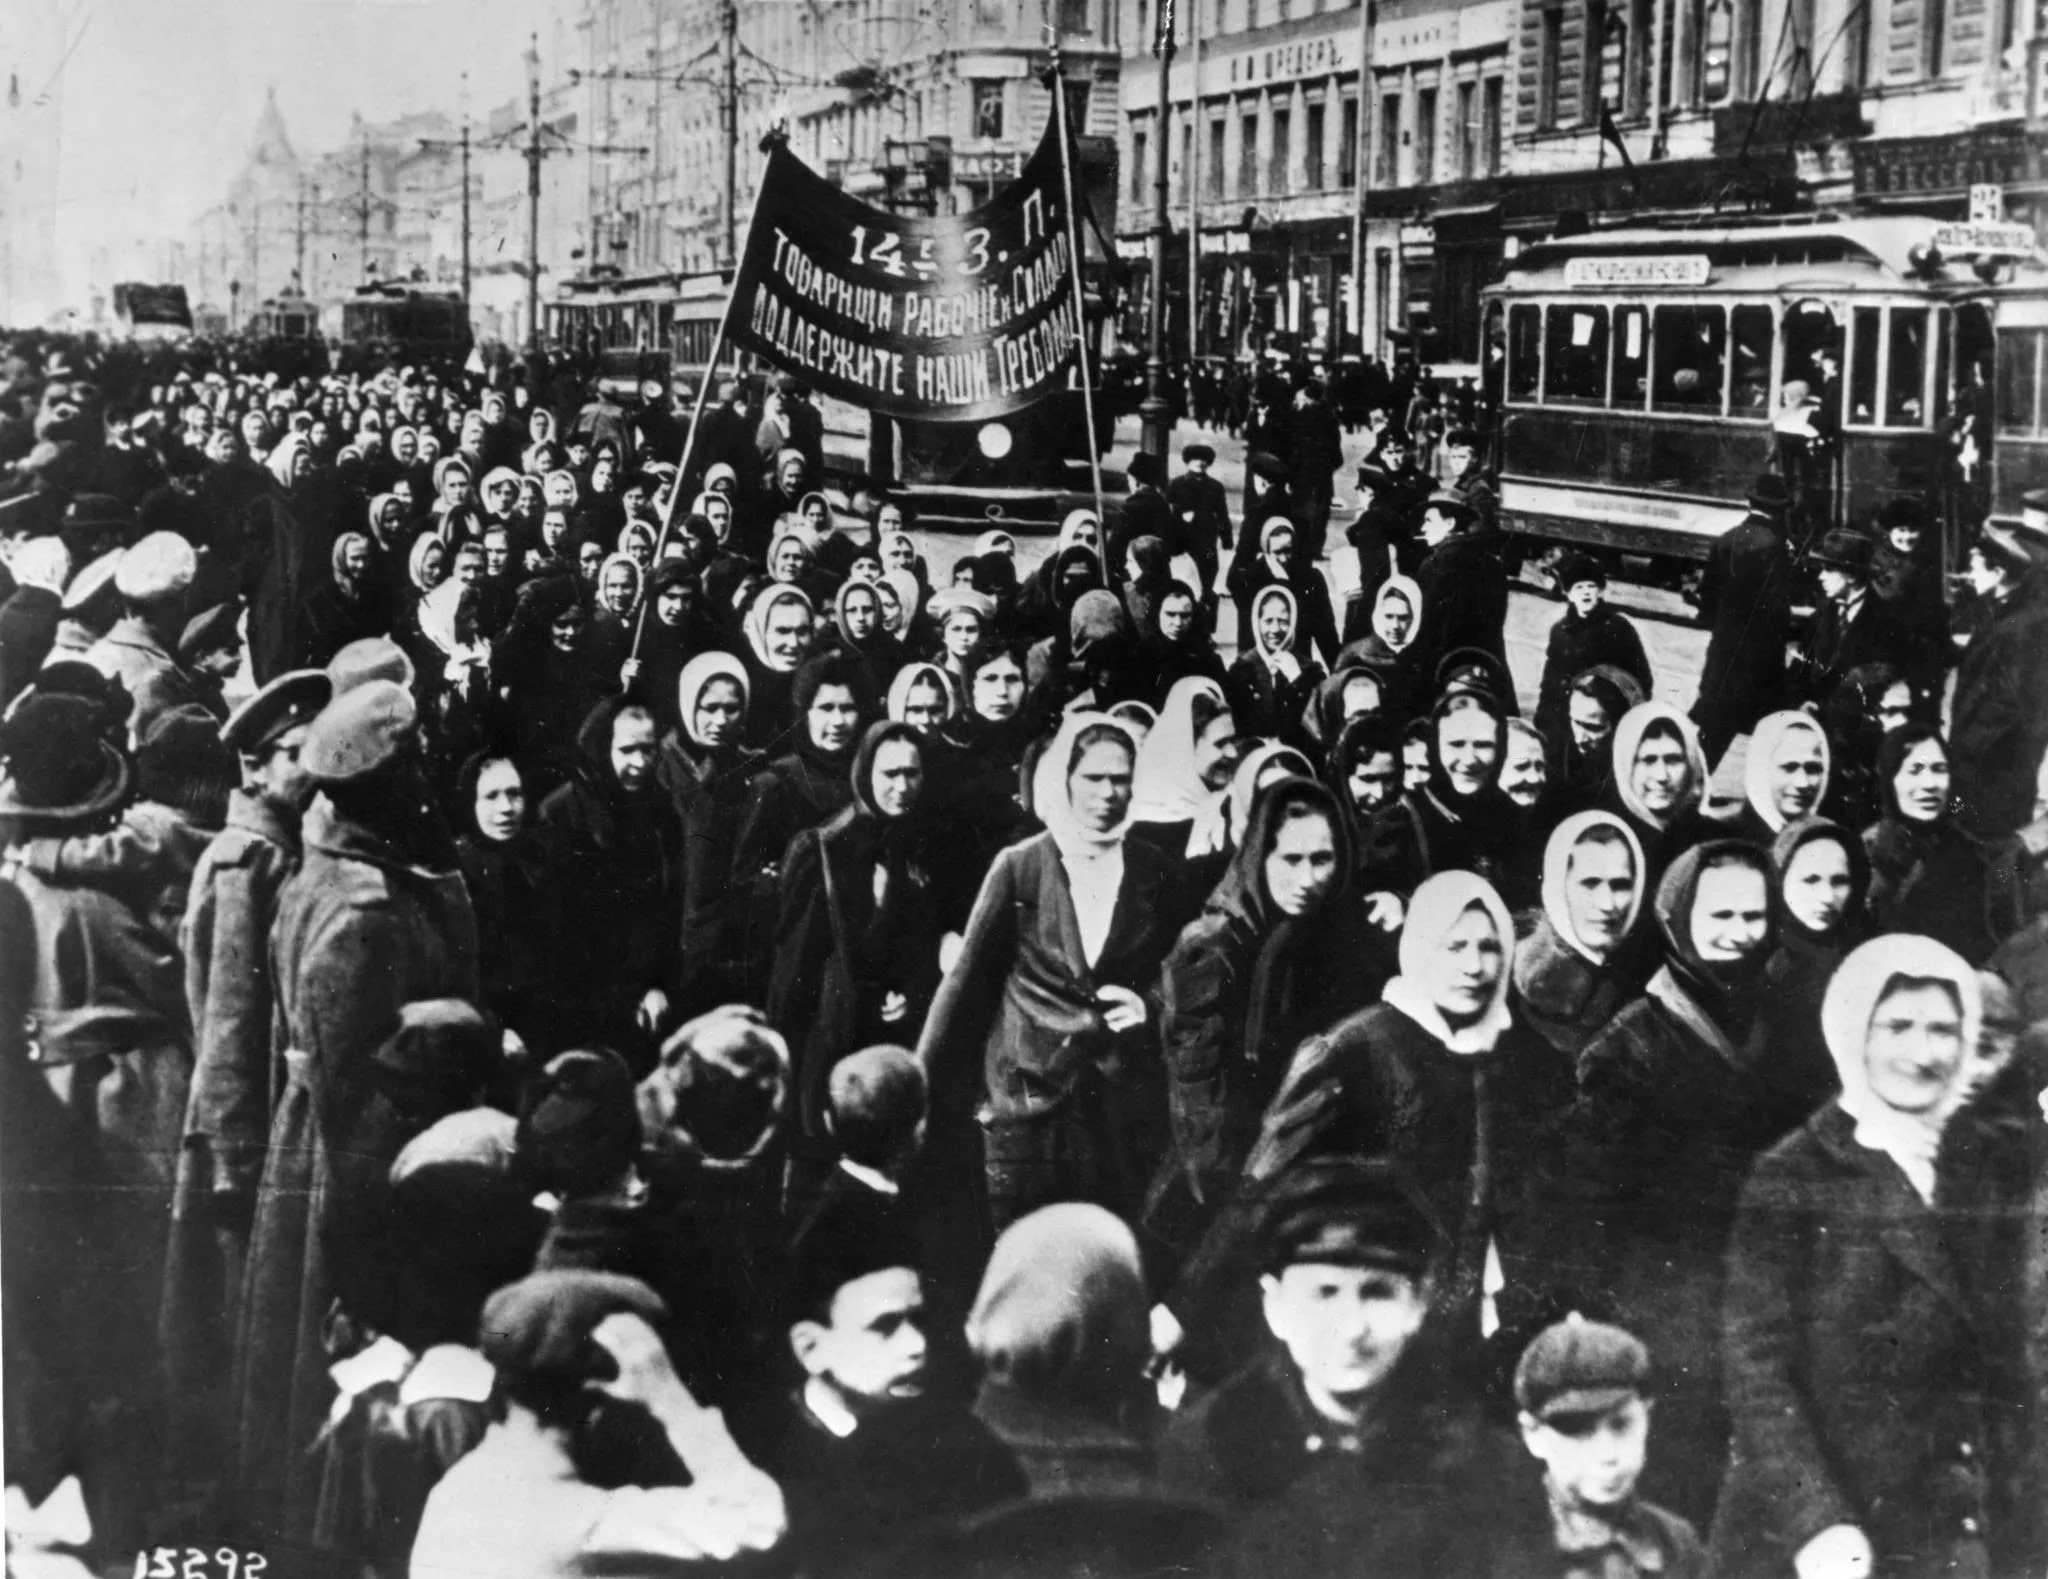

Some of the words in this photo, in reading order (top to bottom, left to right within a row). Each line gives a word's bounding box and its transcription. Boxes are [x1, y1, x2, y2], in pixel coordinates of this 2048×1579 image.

[773, 227, 892, 333] ТОВАРИЩИ
[752, 282, 904, 396] ПОДДЕРЖИТЕ
[917, 349, 990, 404] НАШИ
